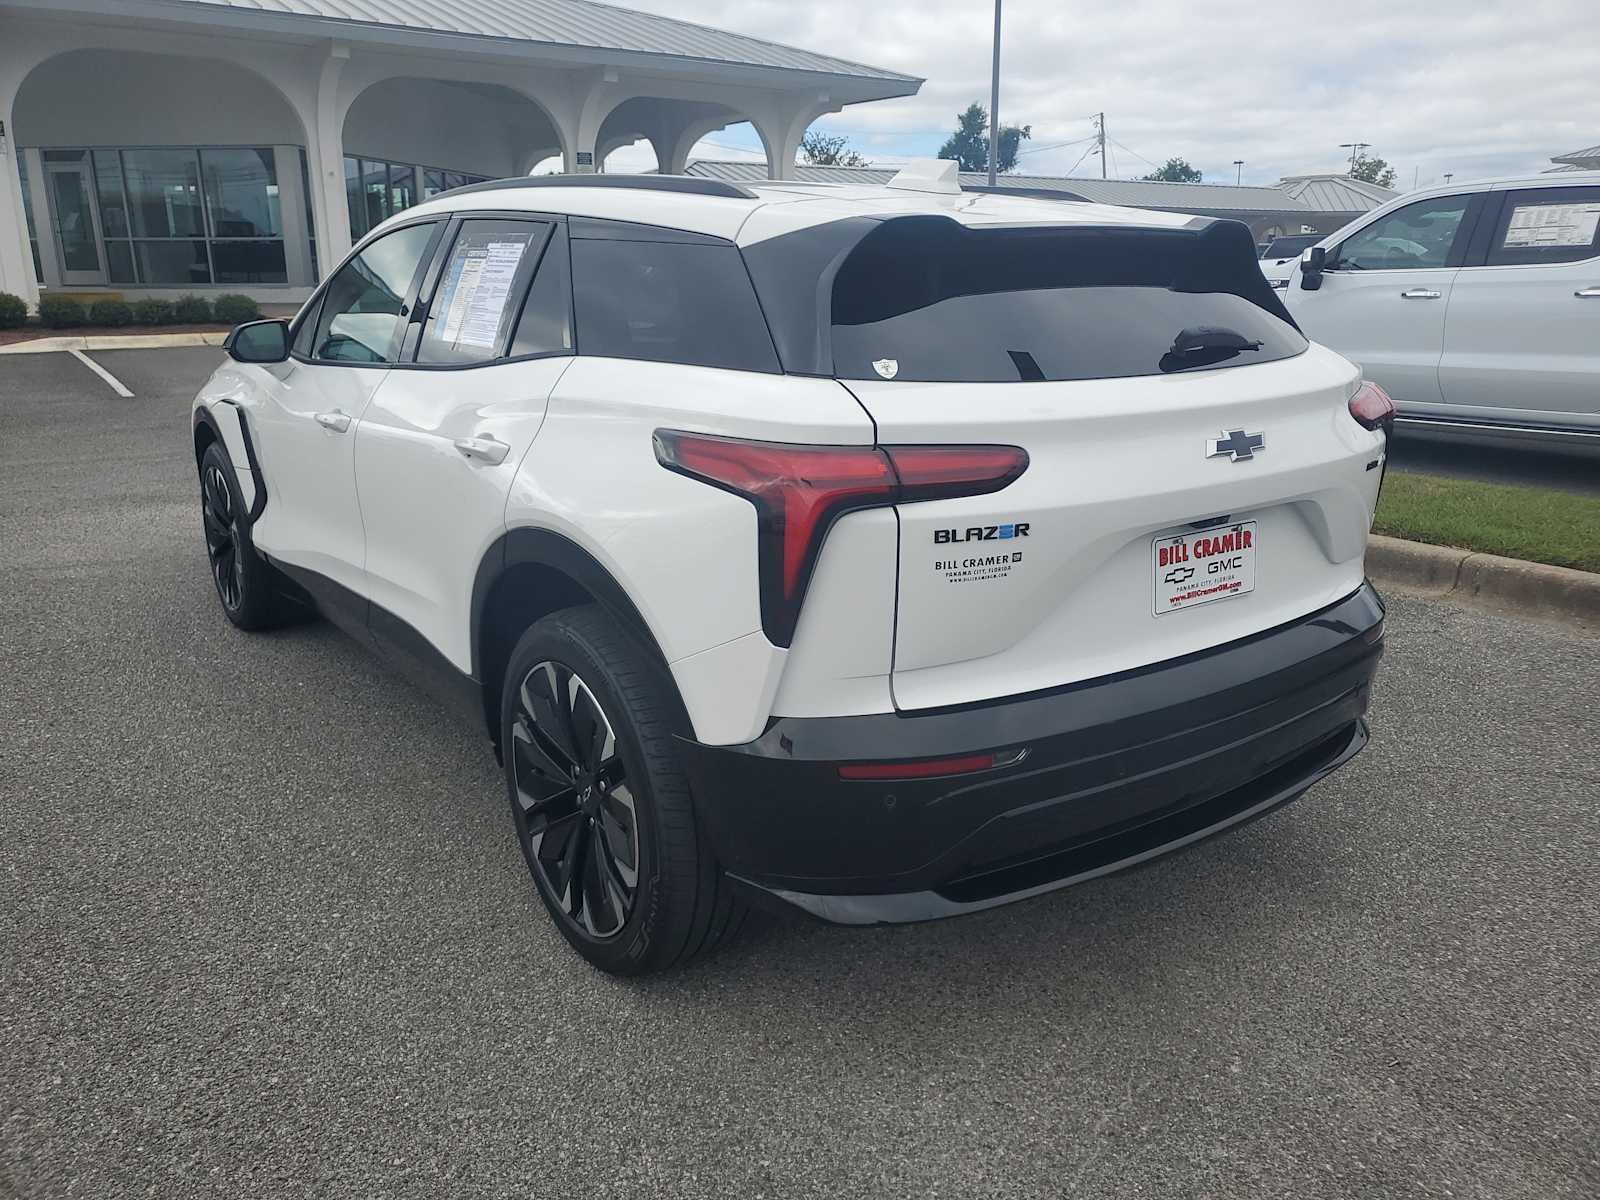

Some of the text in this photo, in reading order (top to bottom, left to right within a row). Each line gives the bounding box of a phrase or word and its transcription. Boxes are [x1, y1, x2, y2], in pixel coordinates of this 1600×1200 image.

[934, 523, 1030, 544] BLAZER
[1160, 531, 1251, 567] BILL CRAMER
[935, 561, 957, 570] BILL
[963, 555, 1009, 568] CRAMER
[1207, 556, 1242, 574] GMC
[1176, 582, 1199, 593] PANAMA
